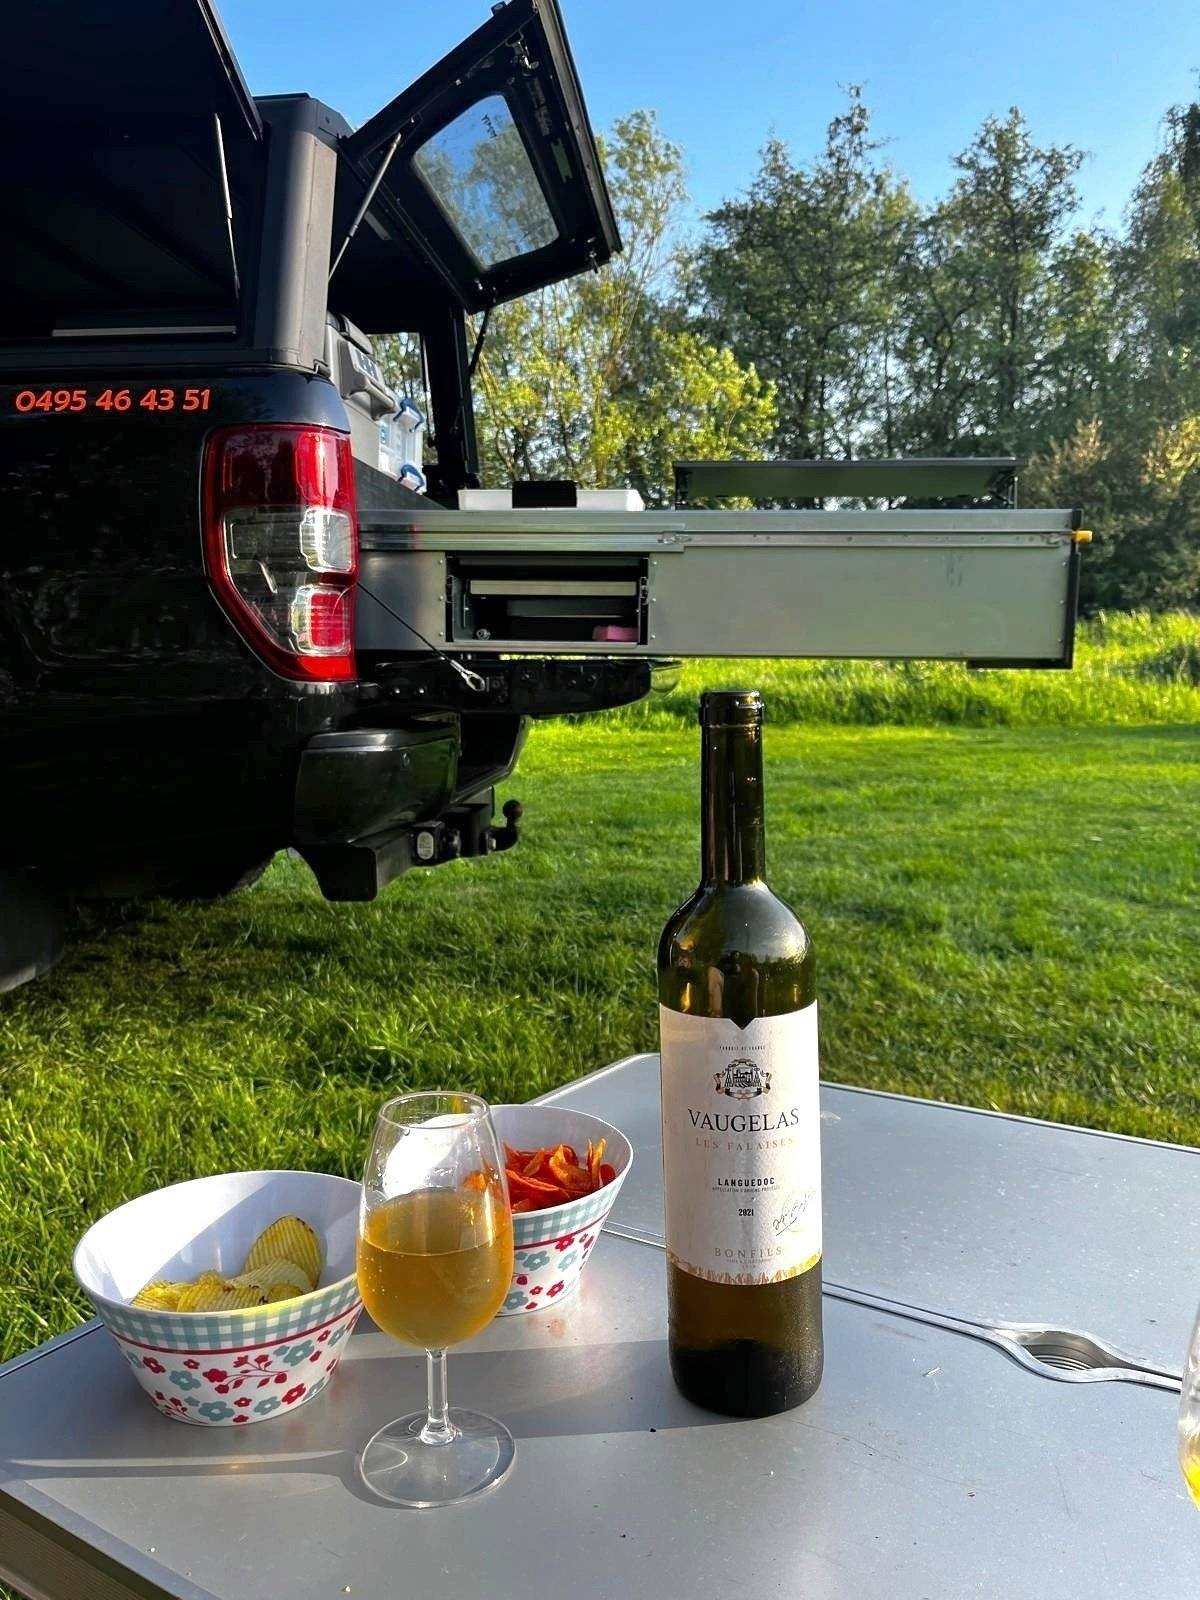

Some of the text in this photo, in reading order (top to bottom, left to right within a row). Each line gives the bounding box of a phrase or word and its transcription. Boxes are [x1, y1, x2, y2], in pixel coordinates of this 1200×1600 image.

[15, 389, 211, 412] 0495 46 43 51
[687, 1107, 800, 1133] VAUGELAS
[695, 1137, 794, 1152] LES FALAISES
[717, 1177, 775, 1187] LANGUEDOC
[737, 1208, 755, 1217] 2021
[714, 1246, 782, 1259] BONFILS
